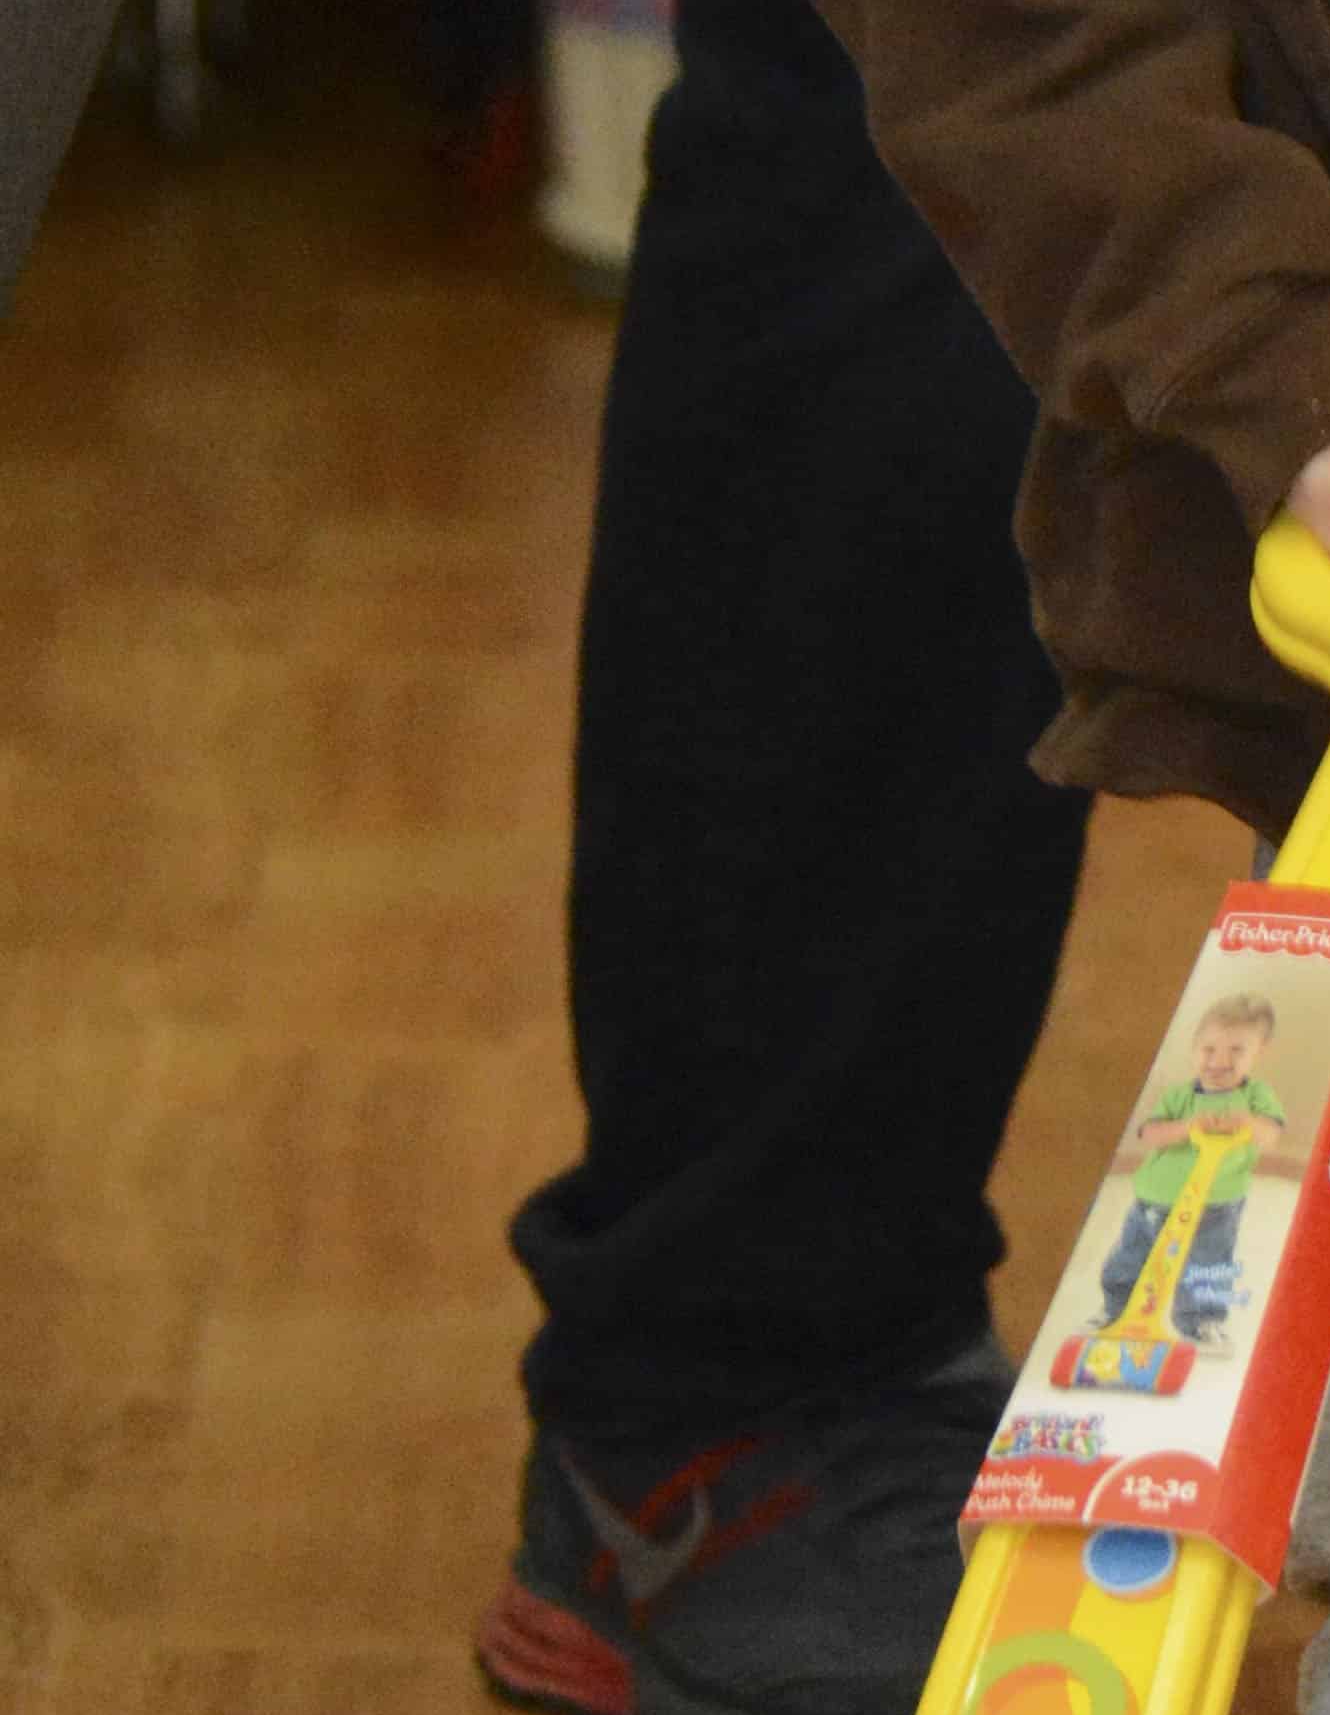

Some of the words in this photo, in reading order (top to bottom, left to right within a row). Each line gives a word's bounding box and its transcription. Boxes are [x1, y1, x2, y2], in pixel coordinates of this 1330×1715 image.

[976, 1468, 1043, 1492] Melody
[1122, 1476, 1198, 1500] 12-36
[967, 1491, 1012, 1512] Push
[1015, 1493, 1077, 1513] Chime
